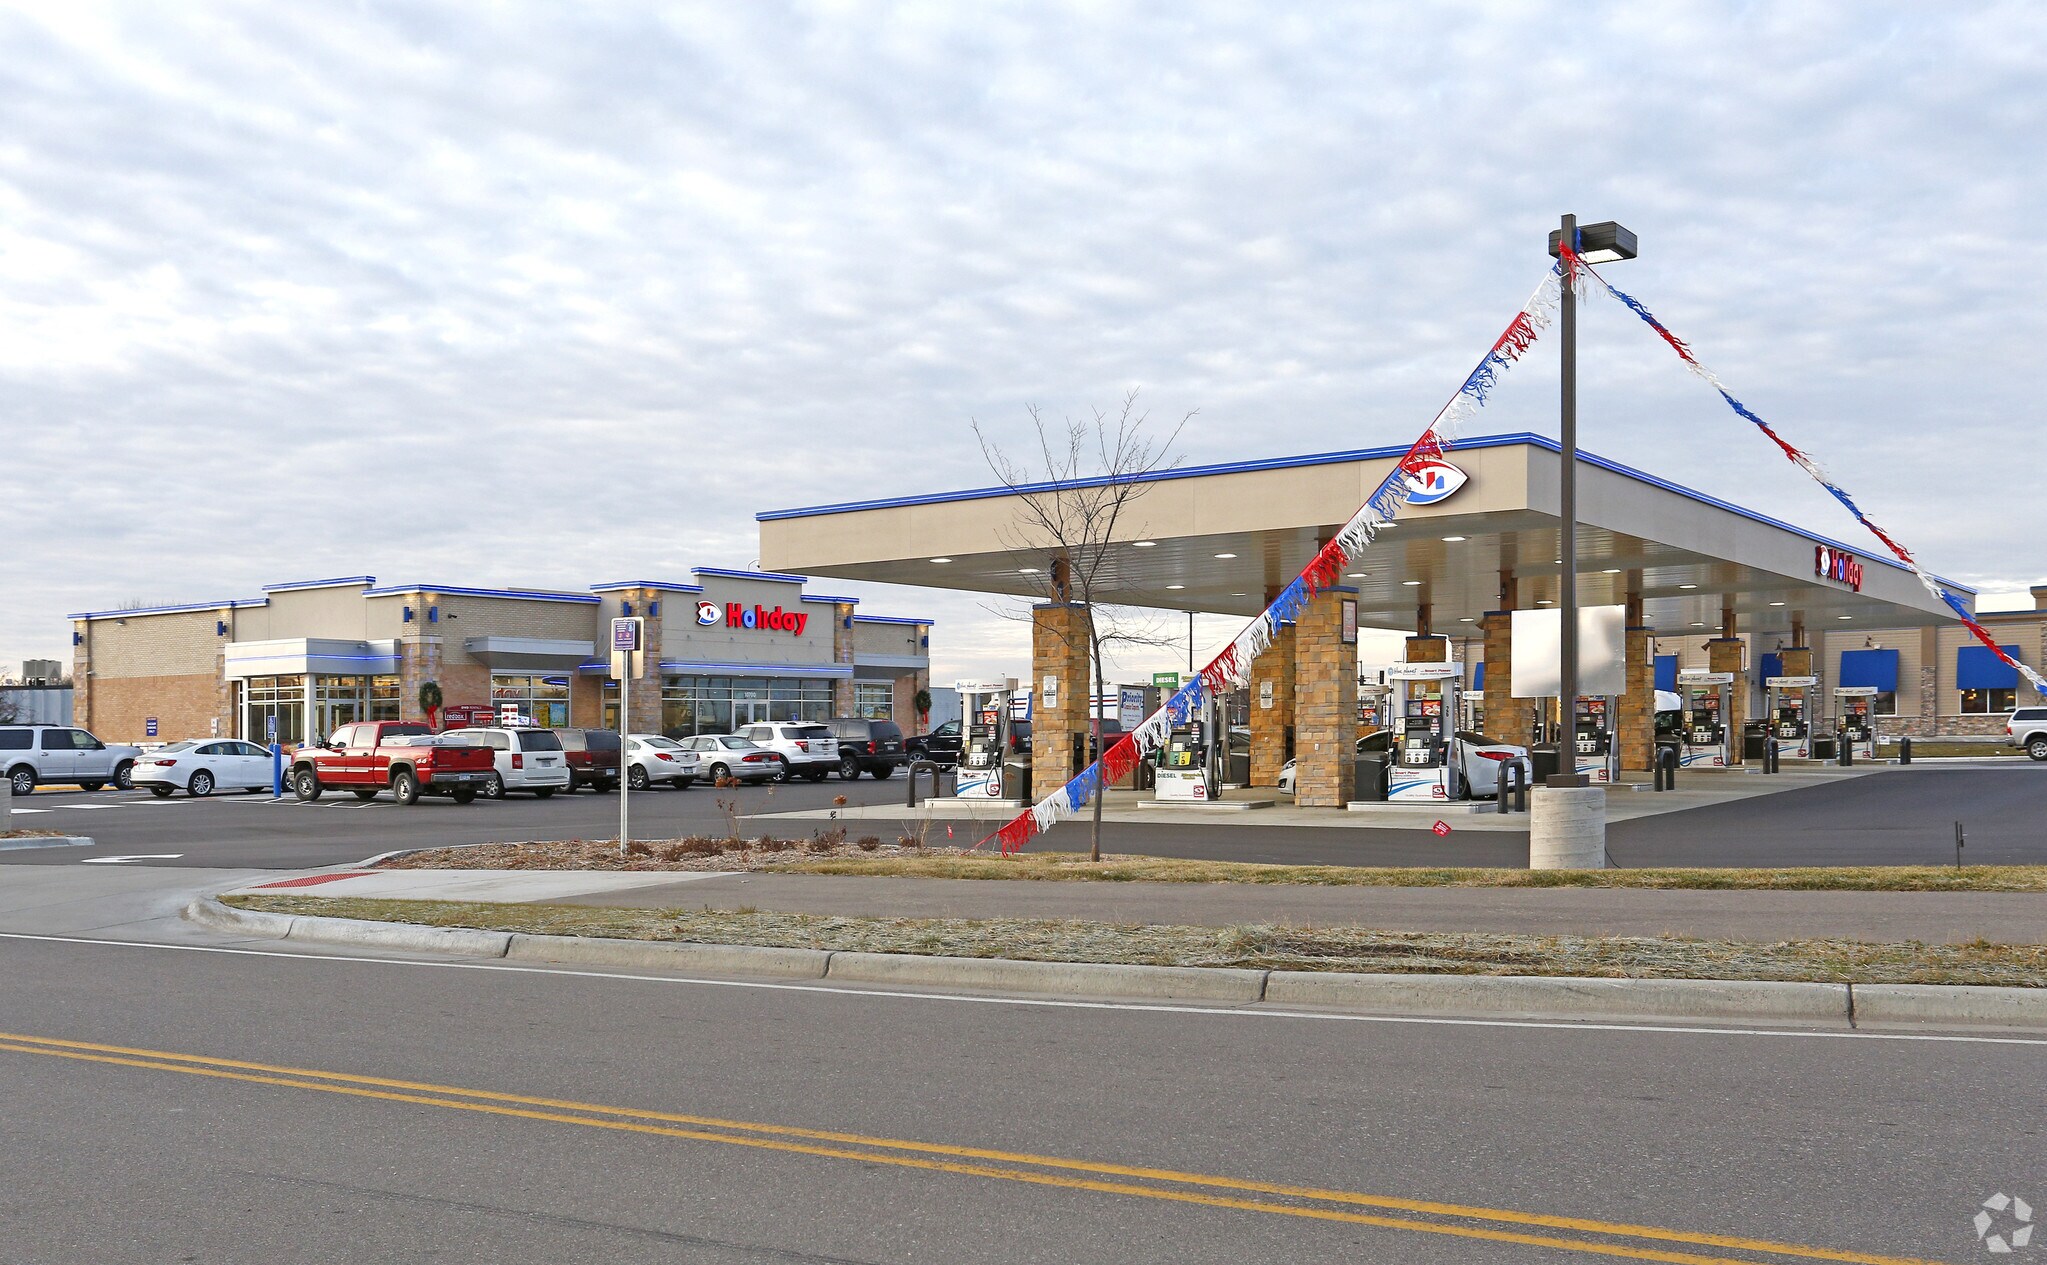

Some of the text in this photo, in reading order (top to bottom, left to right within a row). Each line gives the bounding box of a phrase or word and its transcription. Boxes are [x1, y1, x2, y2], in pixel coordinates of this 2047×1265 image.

[1827, 548, 1863, 593] Holiday
[726, 602, 808, 636] Holiday
[1156, 676, 1177, 684] DIESEL
